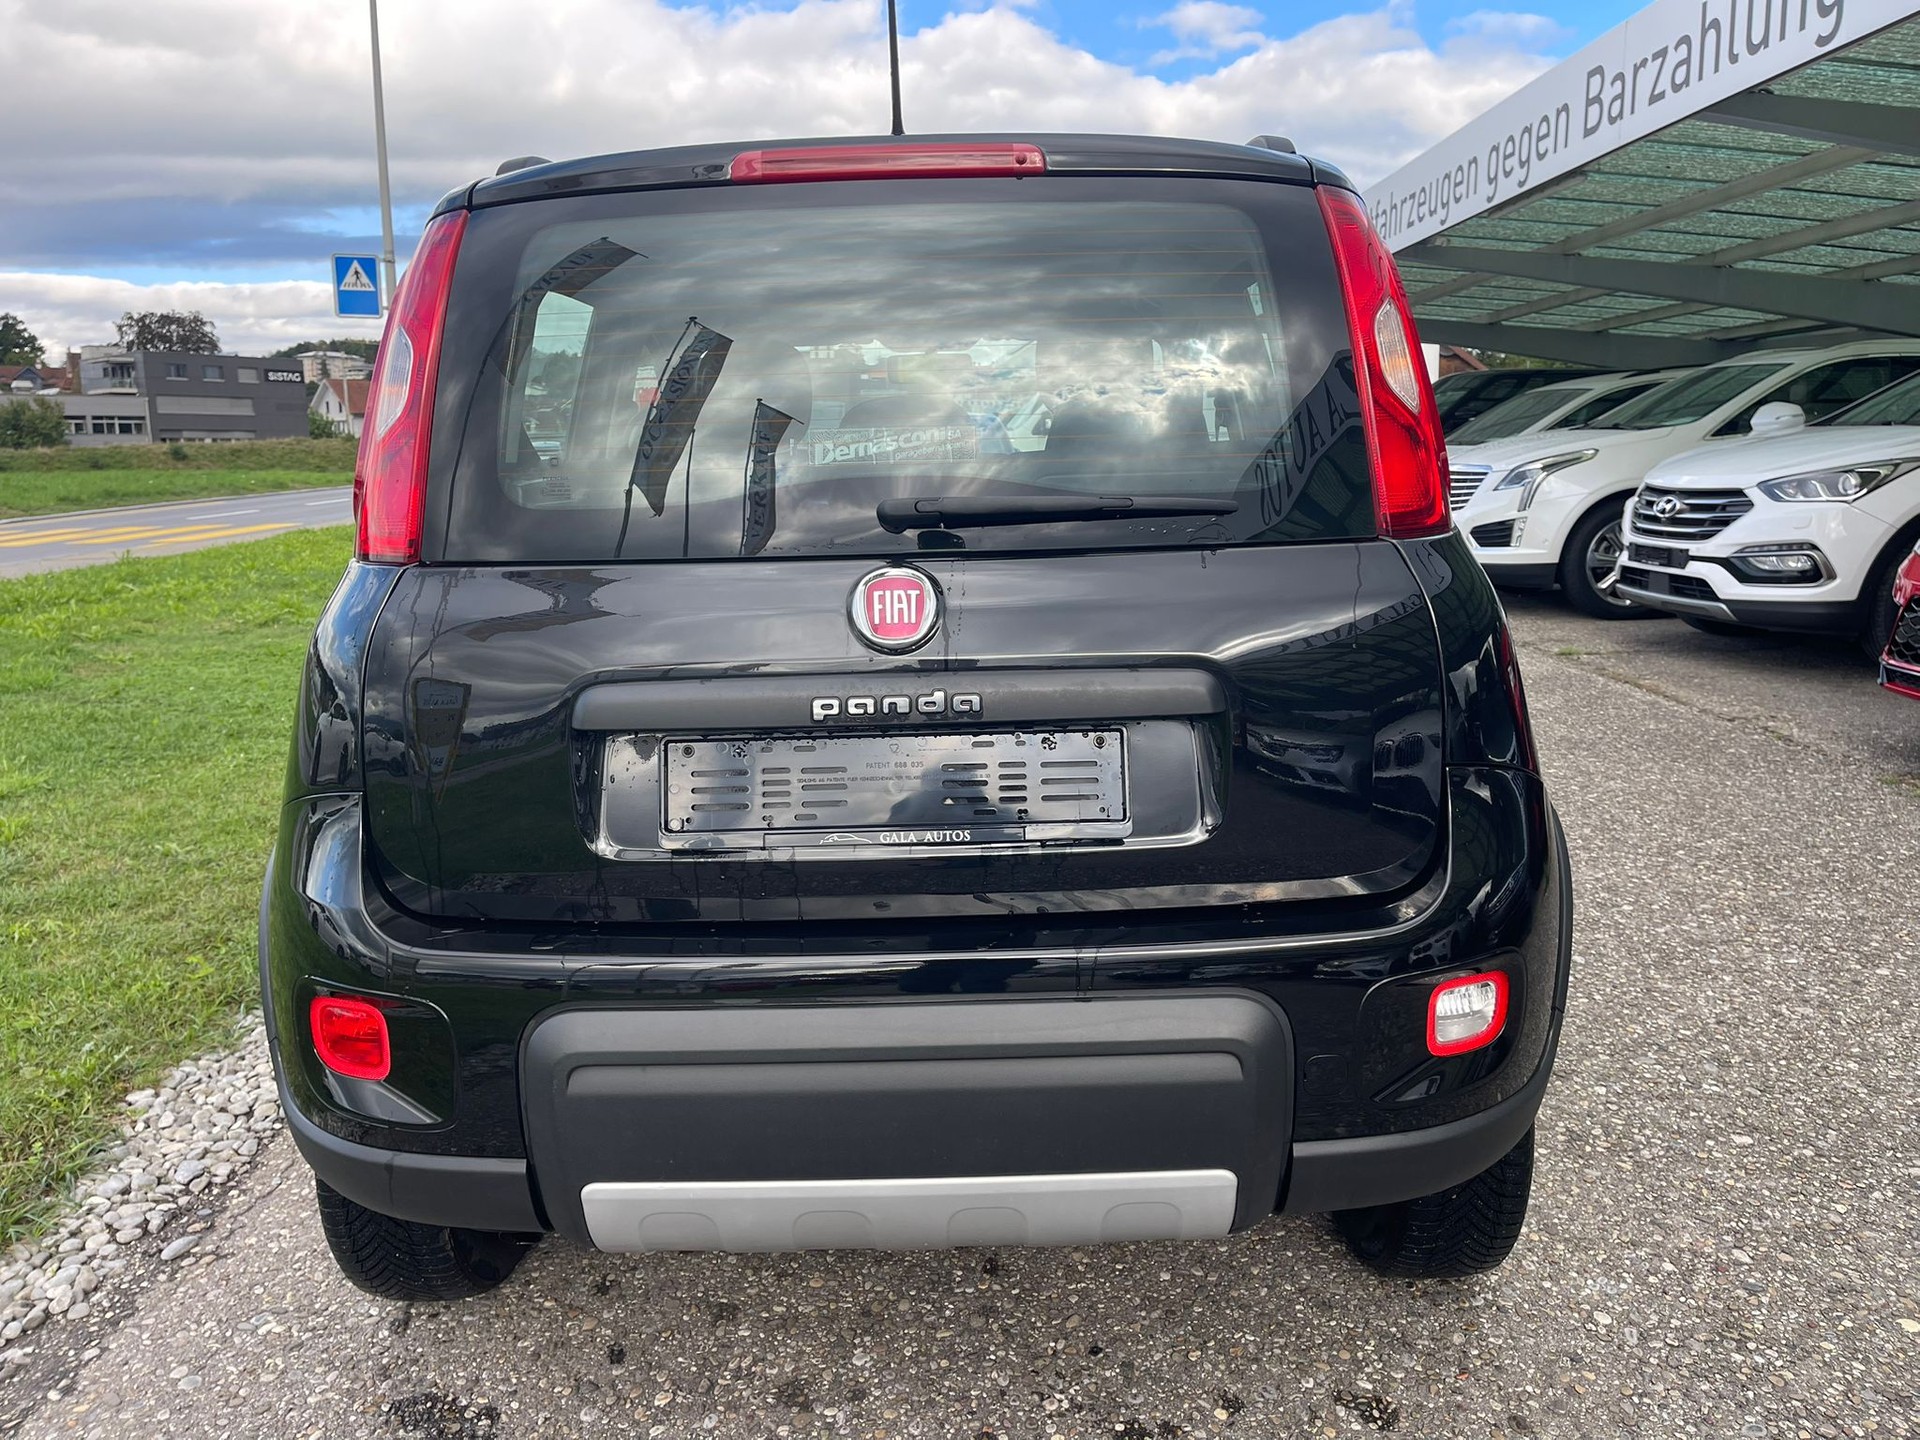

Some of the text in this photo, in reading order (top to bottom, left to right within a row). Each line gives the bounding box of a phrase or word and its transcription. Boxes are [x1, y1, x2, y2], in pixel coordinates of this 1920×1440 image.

[1486, 101, 1571, 204] gegen
[267, 371, 302, 382] SISTAG
[872, 590, 921, 625] FIAT
[811, 688, 983, 722] panda
[879, 830, 971, 844] GALA AUTOS
